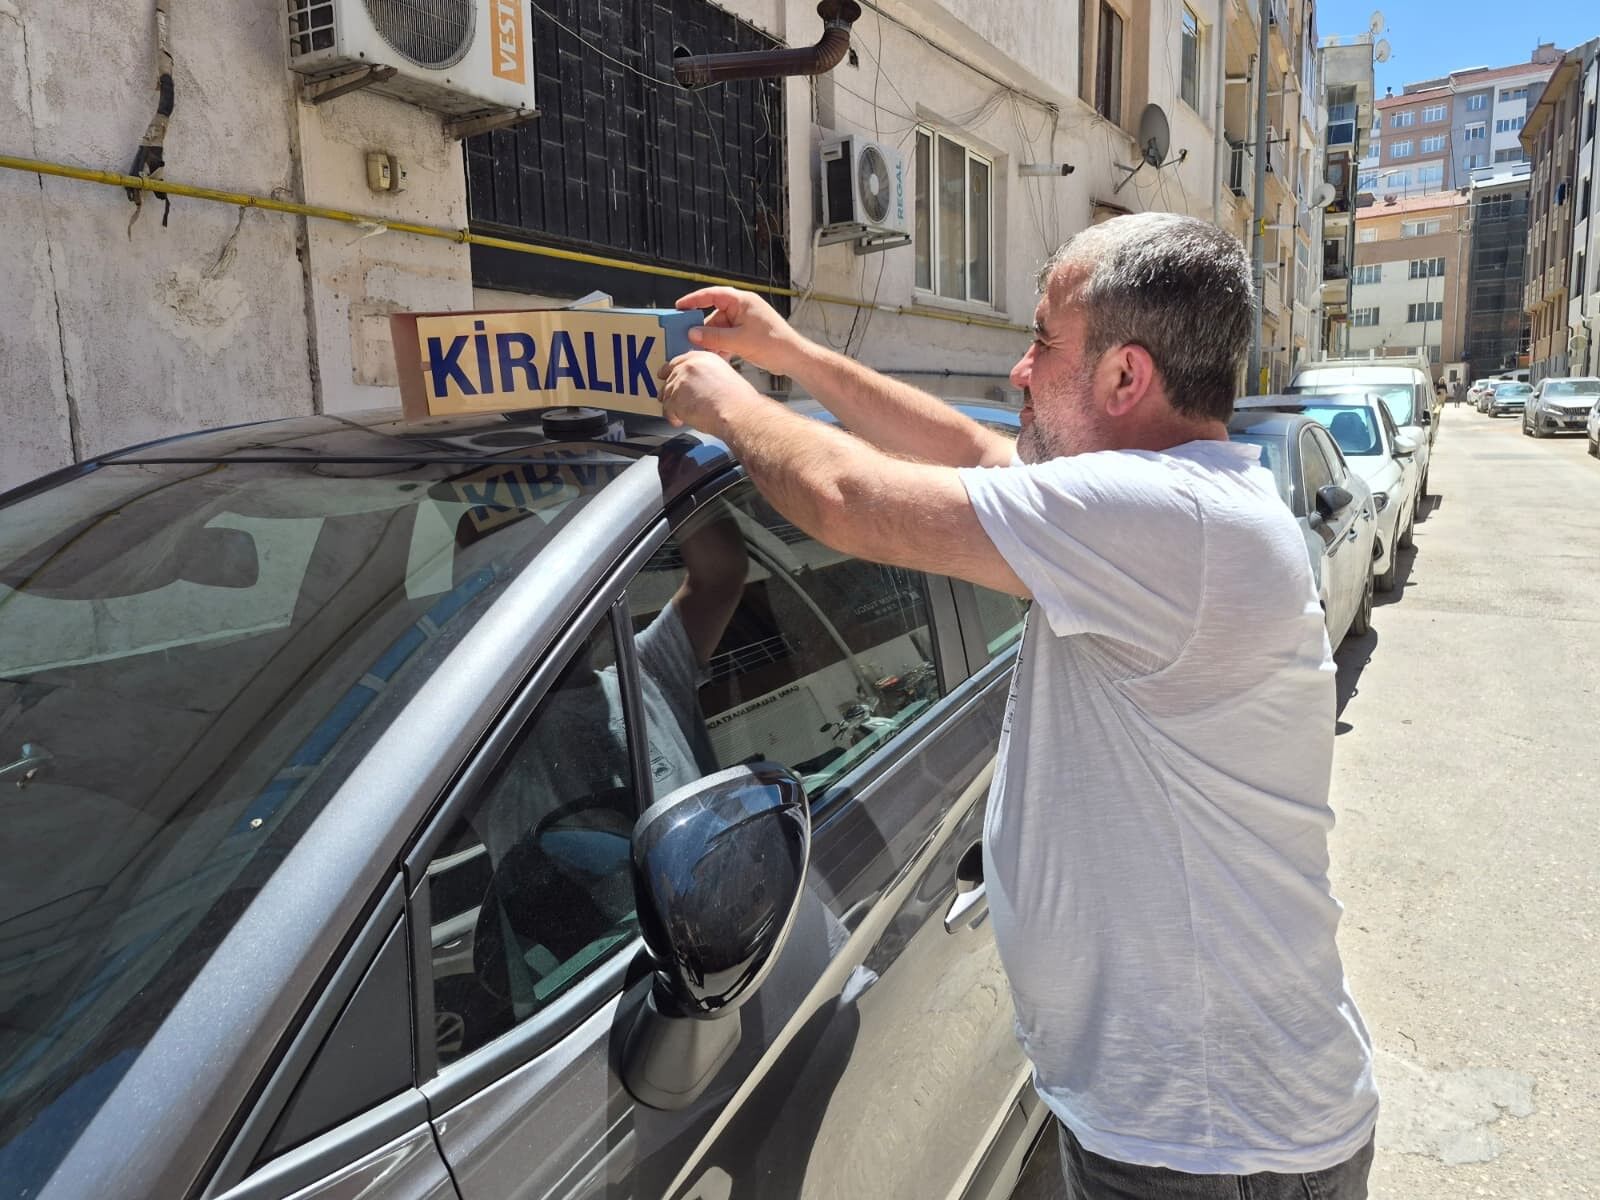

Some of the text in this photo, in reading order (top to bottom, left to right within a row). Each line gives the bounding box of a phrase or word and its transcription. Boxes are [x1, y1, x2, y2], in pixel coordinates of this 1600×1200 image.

[497, 0, 517, 72] VEST
[895, 159, 905, 220] REGAL
[426, 319, 659, 399] KİRALIK
